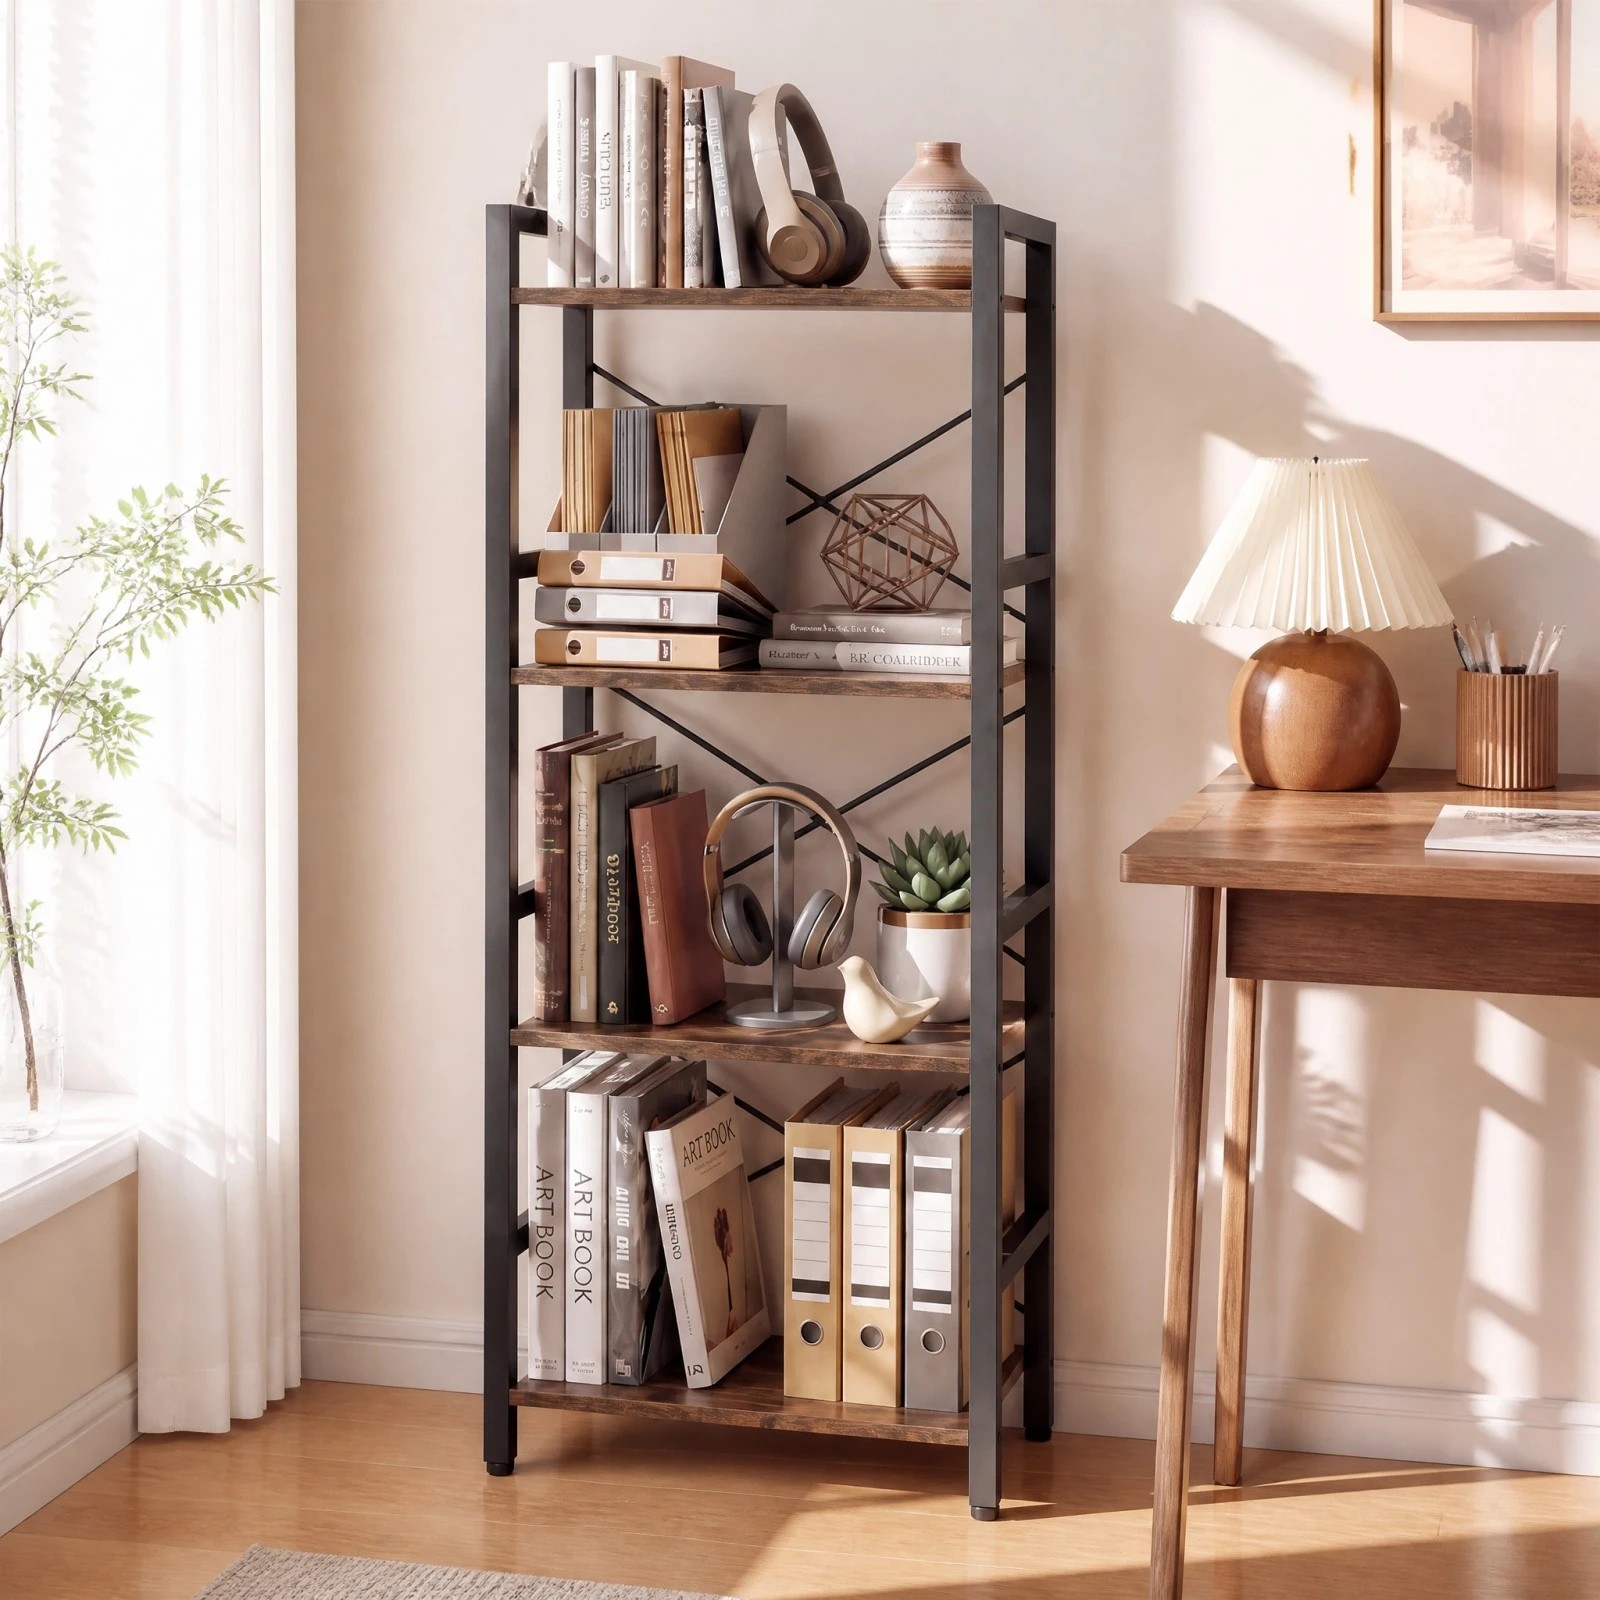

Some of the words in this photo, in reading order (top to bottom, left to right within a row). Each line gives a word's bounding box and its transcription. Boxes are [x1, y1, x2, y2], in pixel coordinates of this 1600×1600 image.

[683, 1135, 703, 1168] ART
[704, 1117, 736, 1154] BOOK
[535, 1165, 554, 1216] ART
[574, 1169, 593, 1221] ART
[535, 1225, 554, 1299] BOOK
[574, 1229, 593, 1304] BOOK
